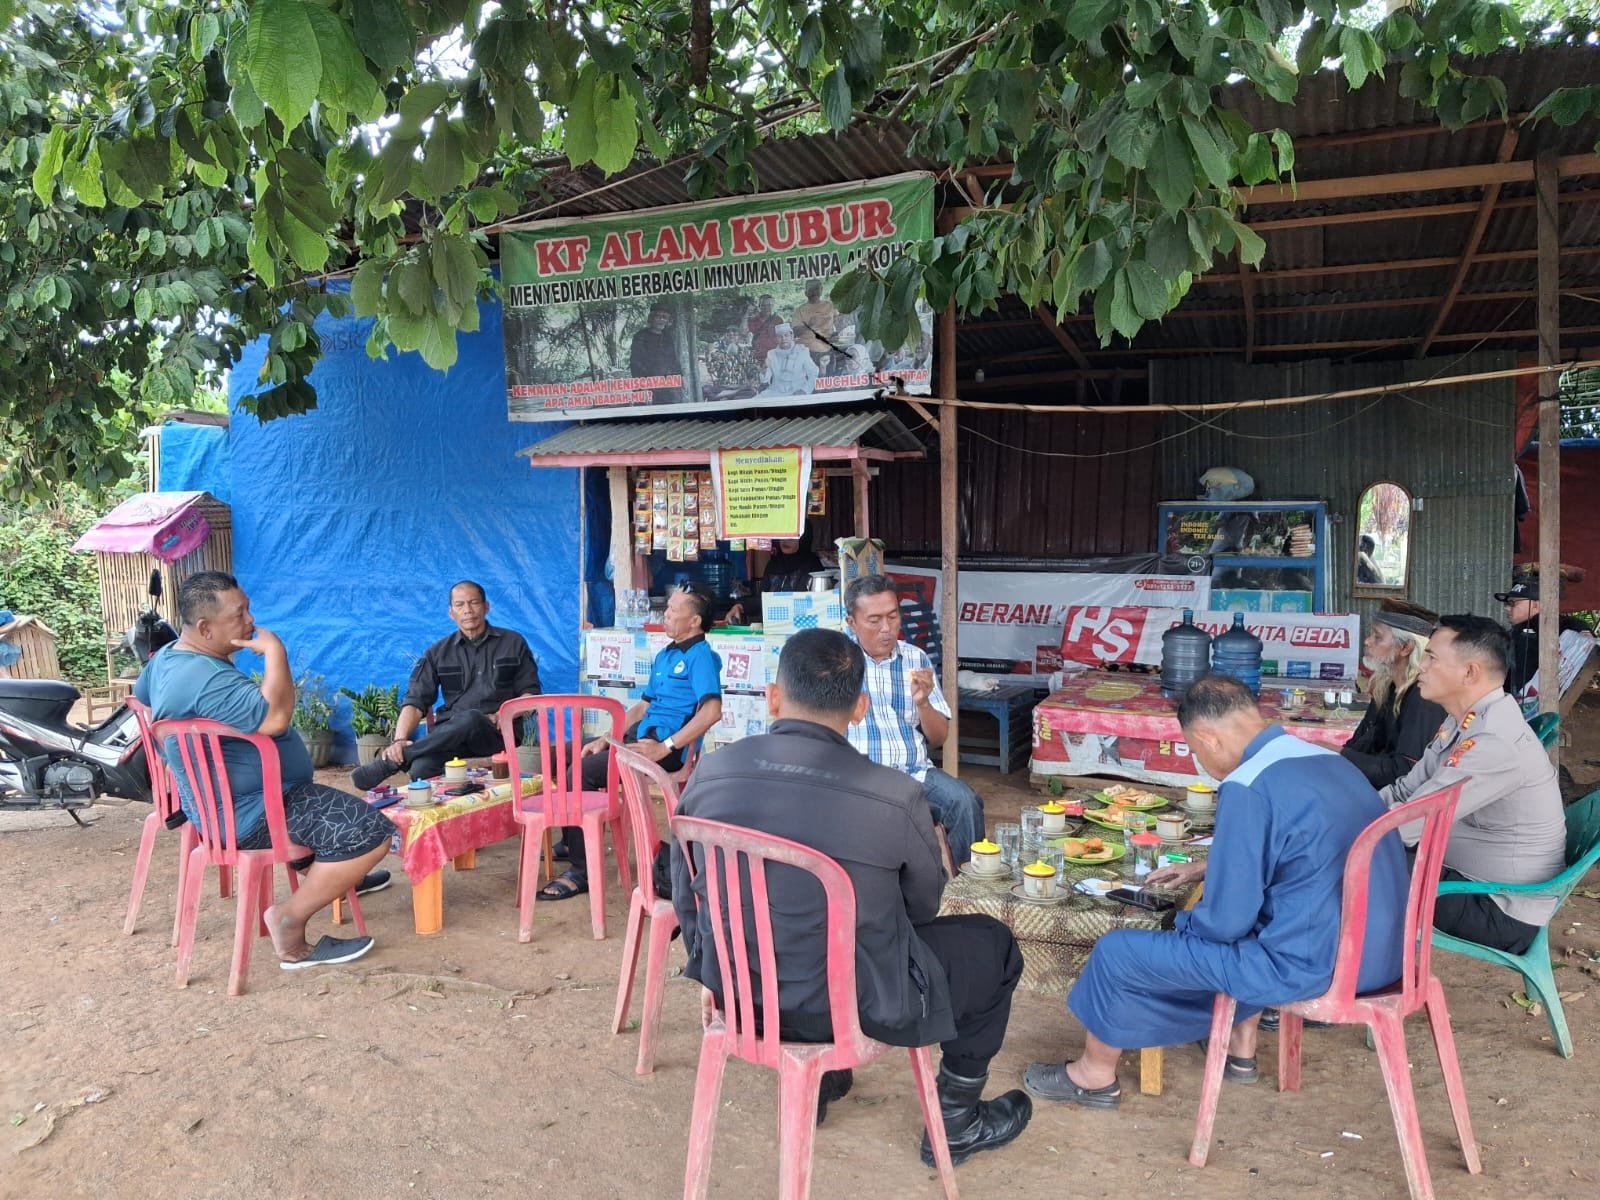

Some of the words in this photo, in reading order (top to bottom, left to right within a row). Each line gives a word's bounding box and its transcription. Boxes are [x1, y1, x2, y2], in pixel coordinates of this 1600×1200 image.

[535, 236, 589, 276] KF
[598, 219, 722, 270] ALAM
[729, 199, 896, 255] KUBUR
[510, 277, 617, 308] MENYEDIAKAN
[621, 267, 699, 297] BERBAGAI
[703, 258, 782, 289] MINUMAN
[786, 252, 841, 281] TANPA
[847, 241, 918, 271] ALKOH
[512, 383, 567, 397] KEMATIAN
[570, 380, 608, 395] ADALAH
[610, 375, 682, 391] KENISCAYAAN
[815, 374, 869, 390] MUCHLIS
[544, 398, 565, 408] APA
[566, 396, 593, 407] AMAL
[594, 392, 629, 406] IBADAH
[959, 602, 1052, 626] BERANI
[1068, 606, 1133, 661] HS
[1291, 627, 1349, 647] BEDA
